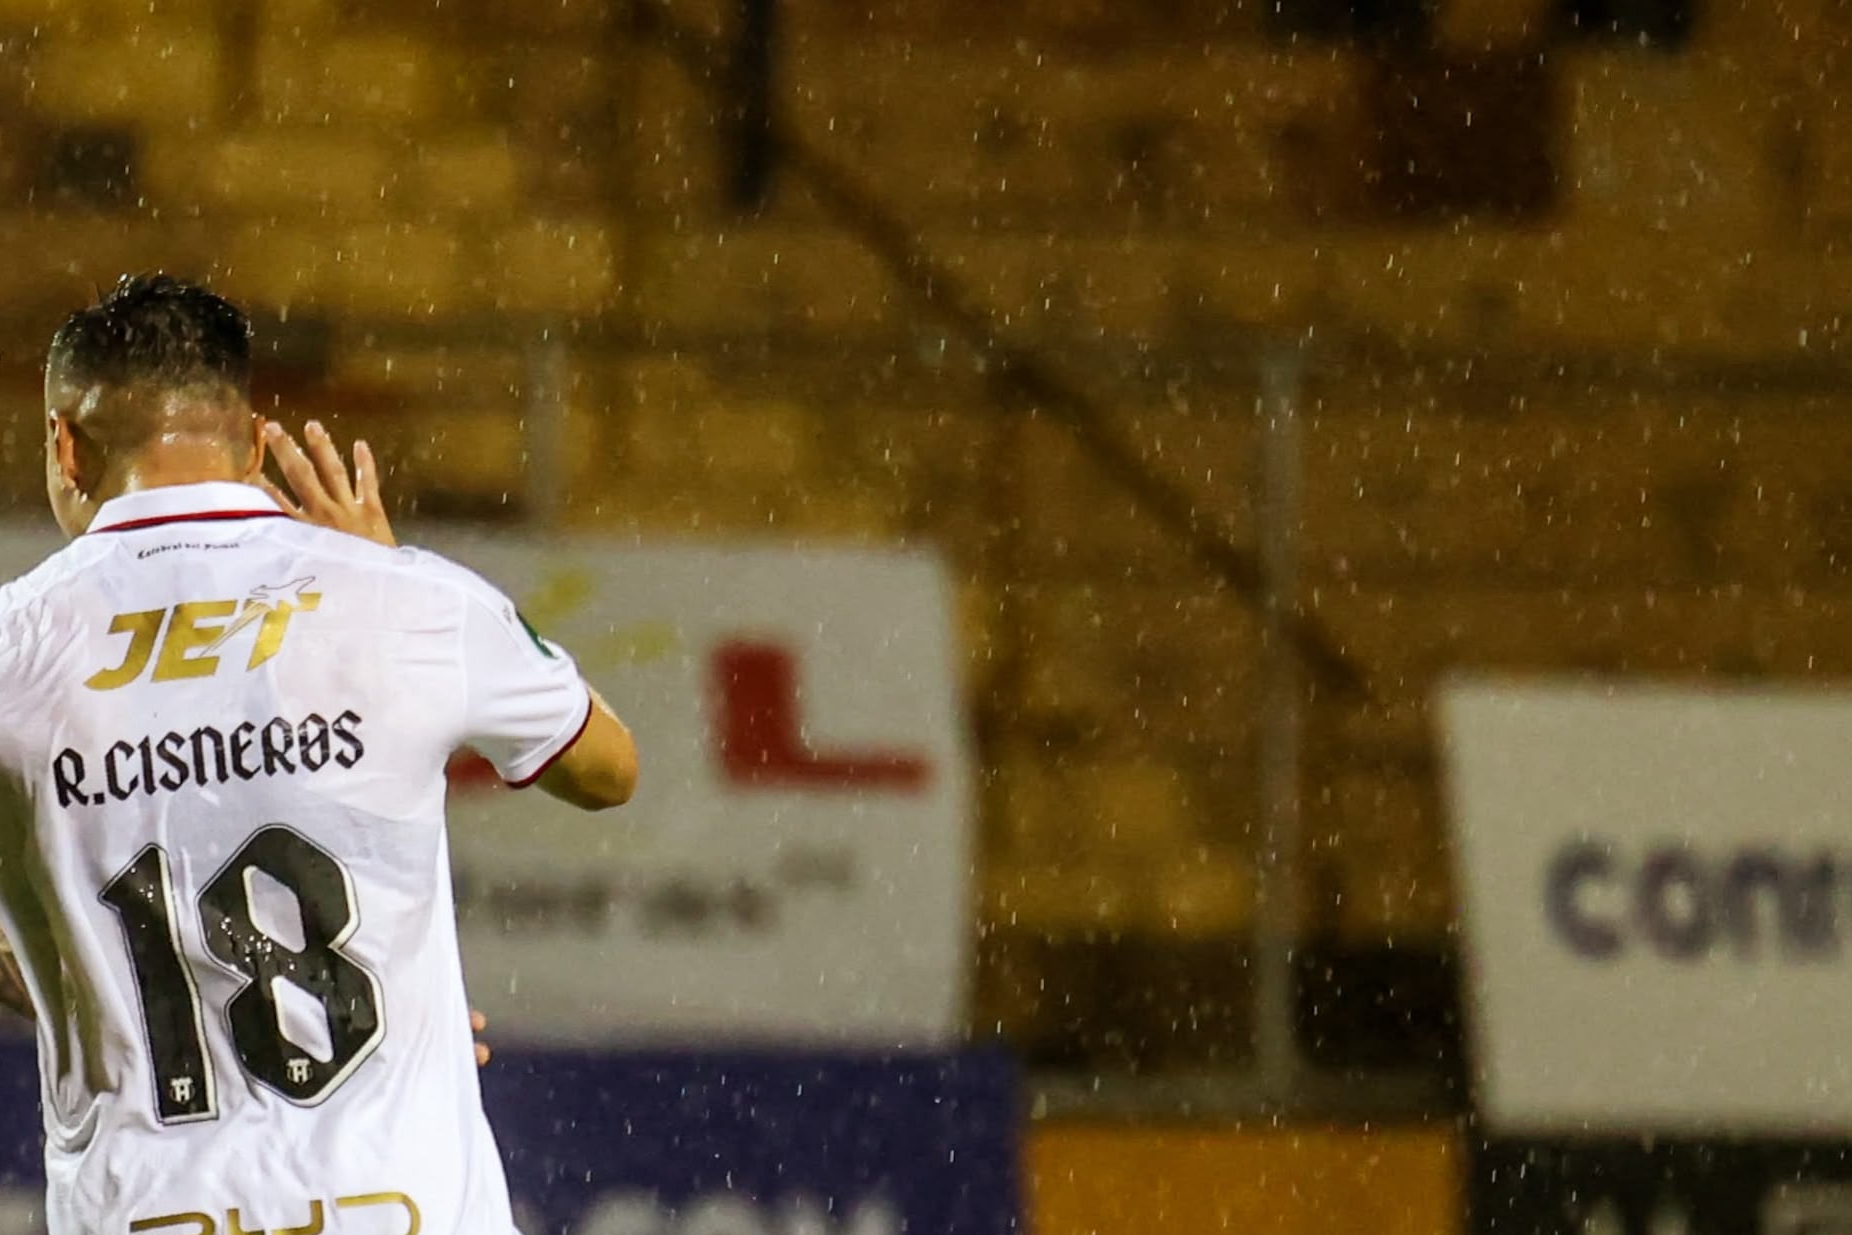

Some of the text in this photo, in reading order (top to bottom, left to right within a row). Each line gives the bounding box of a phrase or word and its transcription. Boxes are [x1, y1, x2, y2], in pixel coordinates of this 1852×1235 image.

[84, 591, 322, 691] JET
[51, 708, 366, 809] R.CISNEROS
[98, 823, 388, 1126] 18
